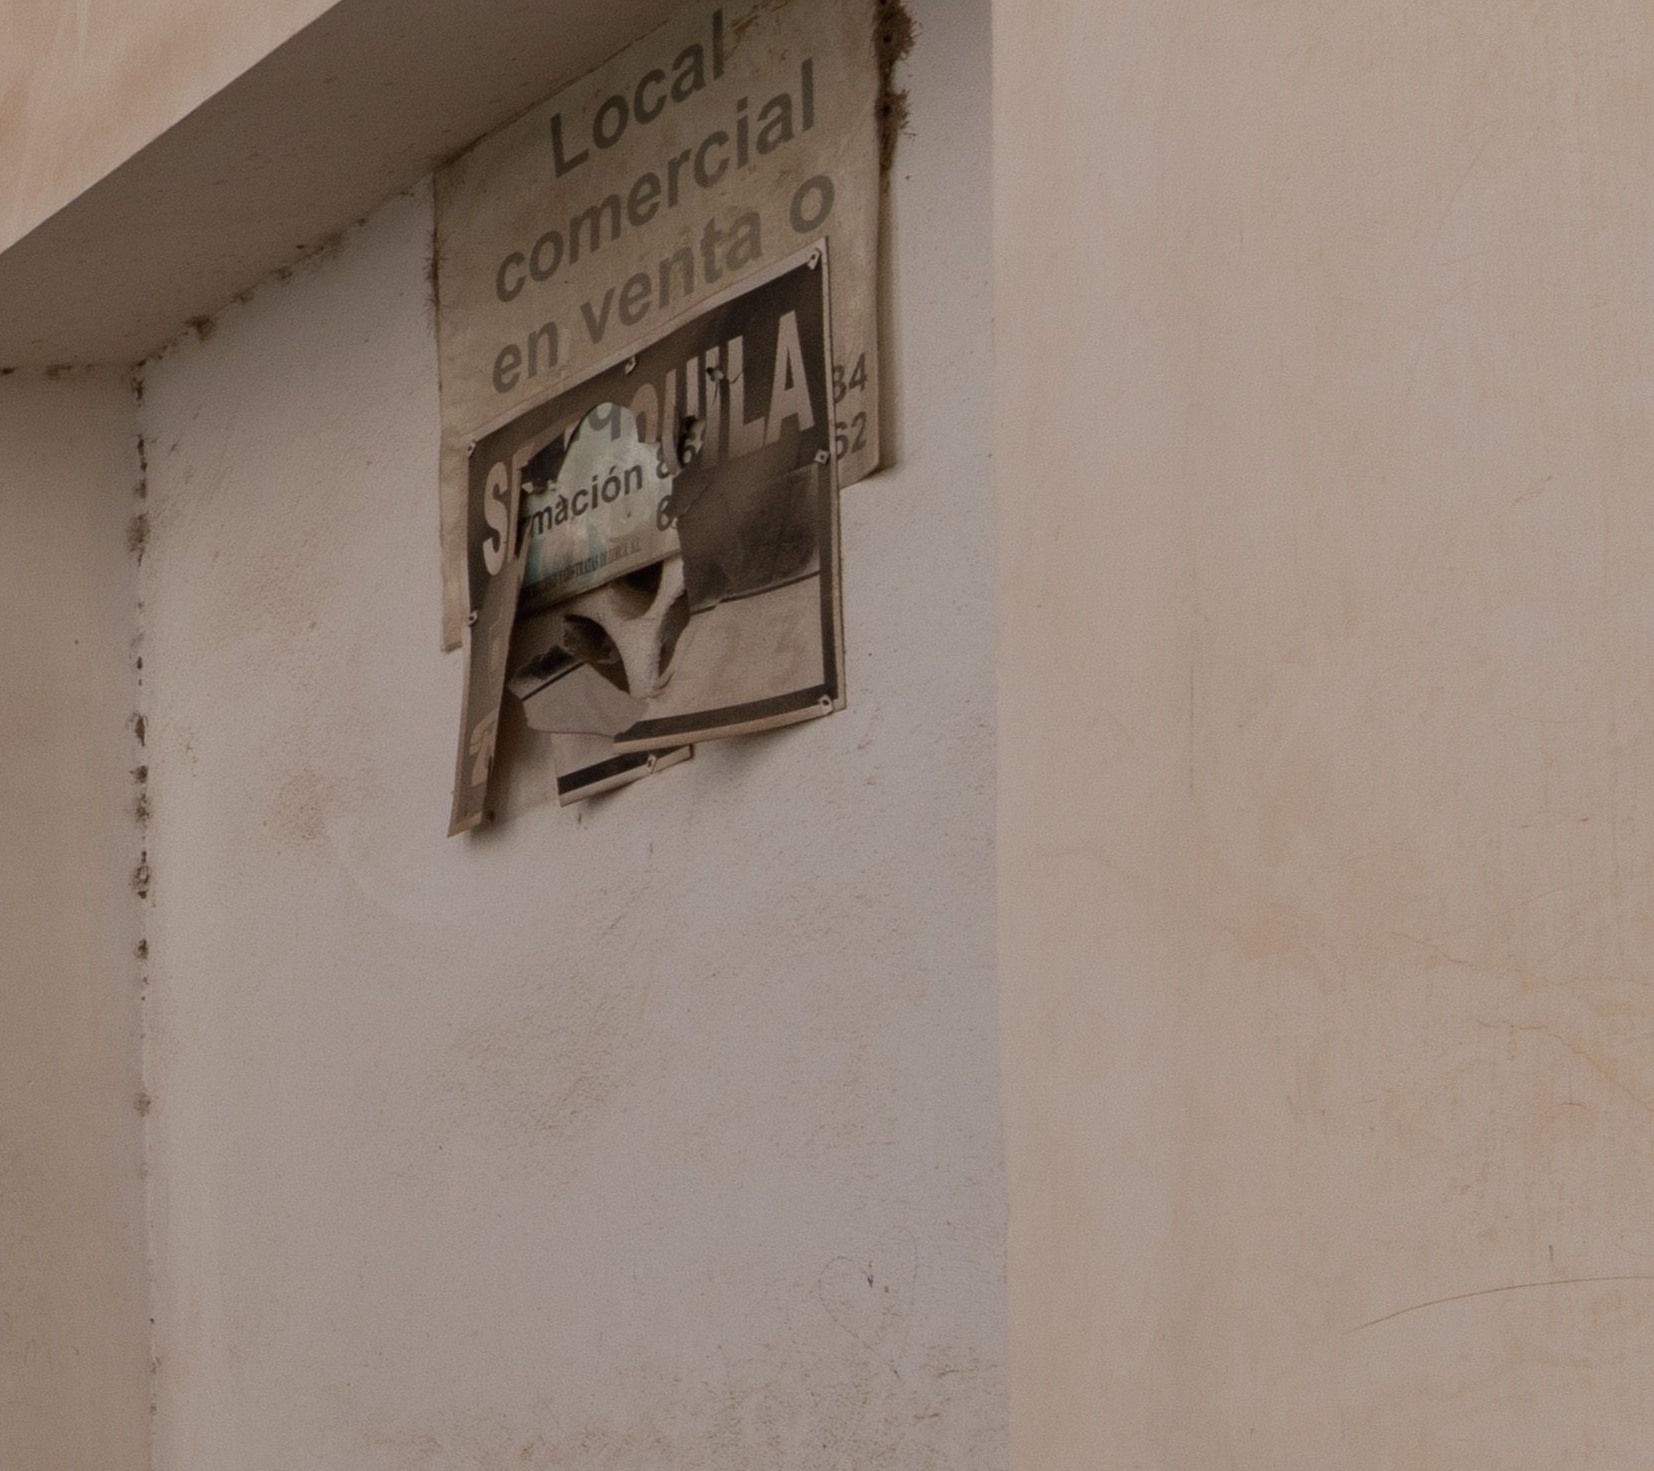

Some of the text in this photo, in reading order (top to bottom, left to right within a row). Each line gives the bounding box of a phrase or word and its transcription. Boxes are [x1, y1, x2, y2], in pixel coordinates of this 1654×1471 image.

[495, 57, 815, 303] comercial
[550, 8, 725, 179] Local
[492, 174, 835, 394] en venta o
